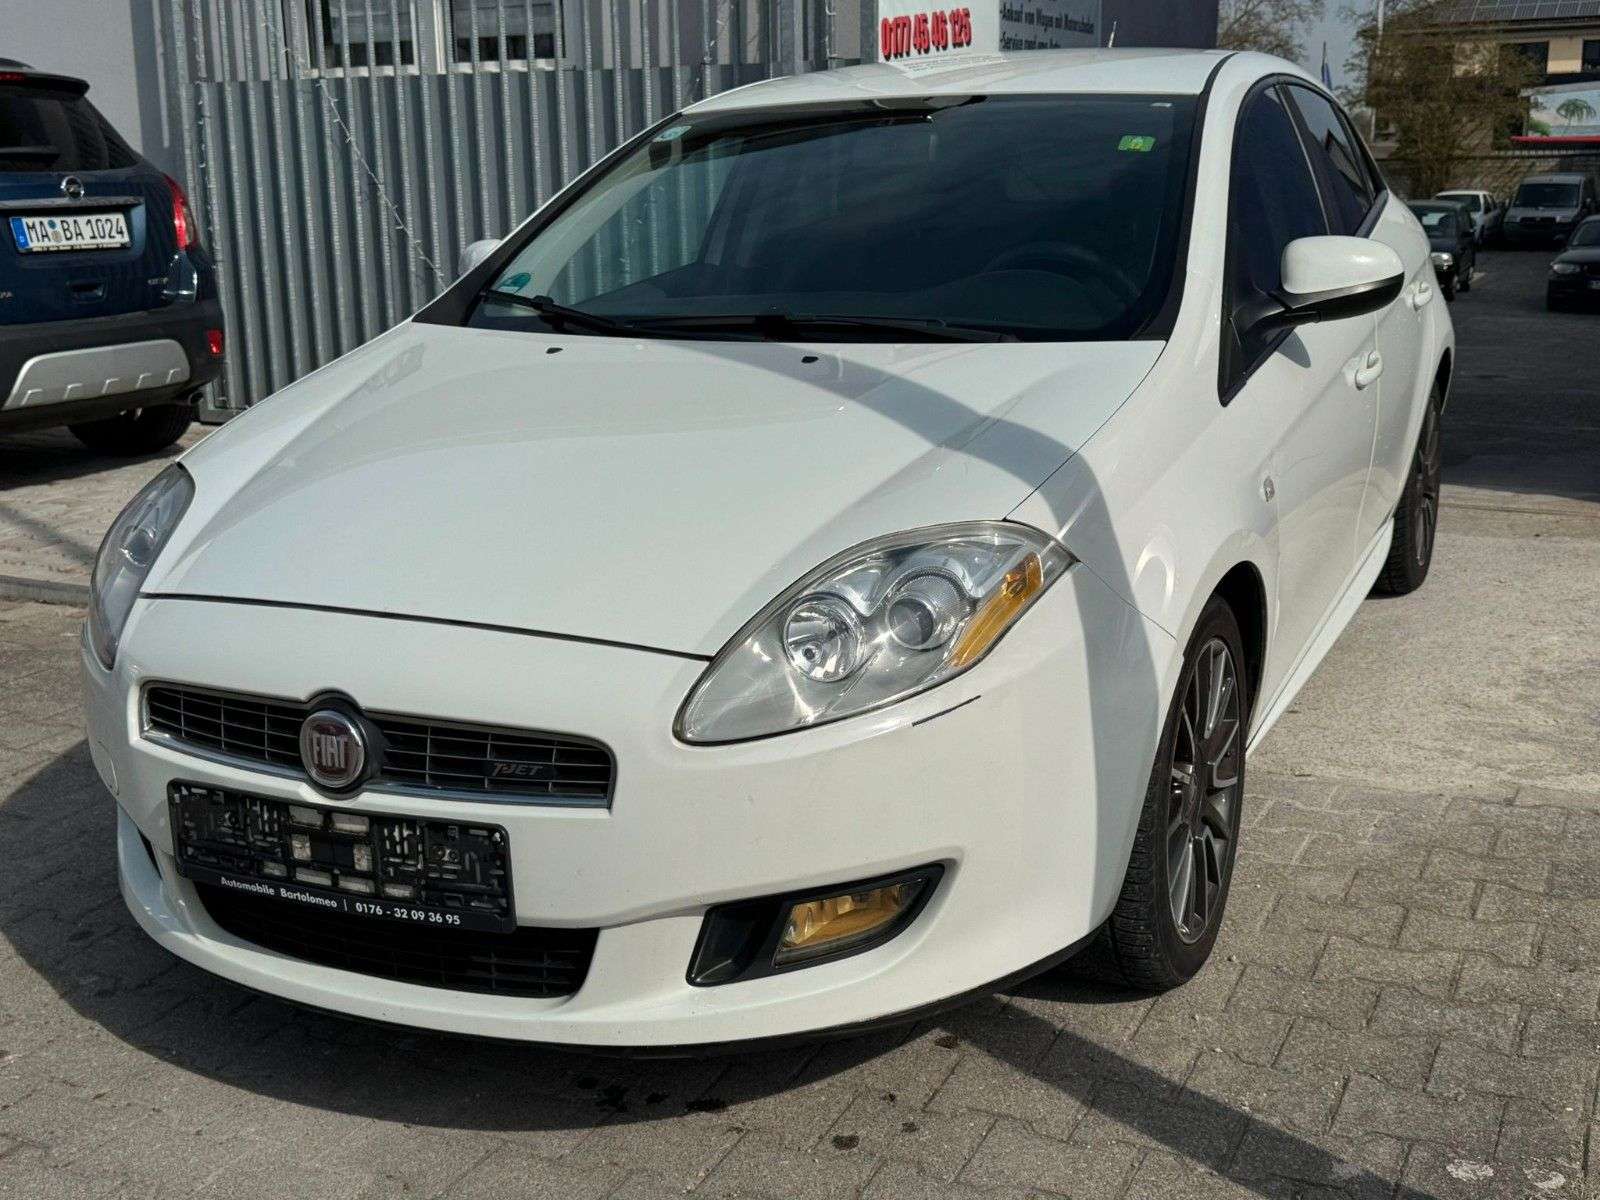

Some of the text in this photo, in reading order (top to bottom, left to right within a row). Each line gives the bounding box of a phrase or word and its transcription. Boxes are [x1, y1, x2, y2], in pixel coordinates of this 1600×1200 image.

[913, 13, 930, 55] 45
[26, 218, 125, 242] MA BA 1024
[311, 732, 348, 769] FIAT
[220, 876, 275, 896] Automobile
[280, 888, 338, 908] Bartolomeo
[355, 902, 383, 915] 0176
[394, 908, 408, 919] 32
[411, 910, 425, 921] 09
[428, 912, 443, 923] 36
[445, 914, 461, 925] 95
